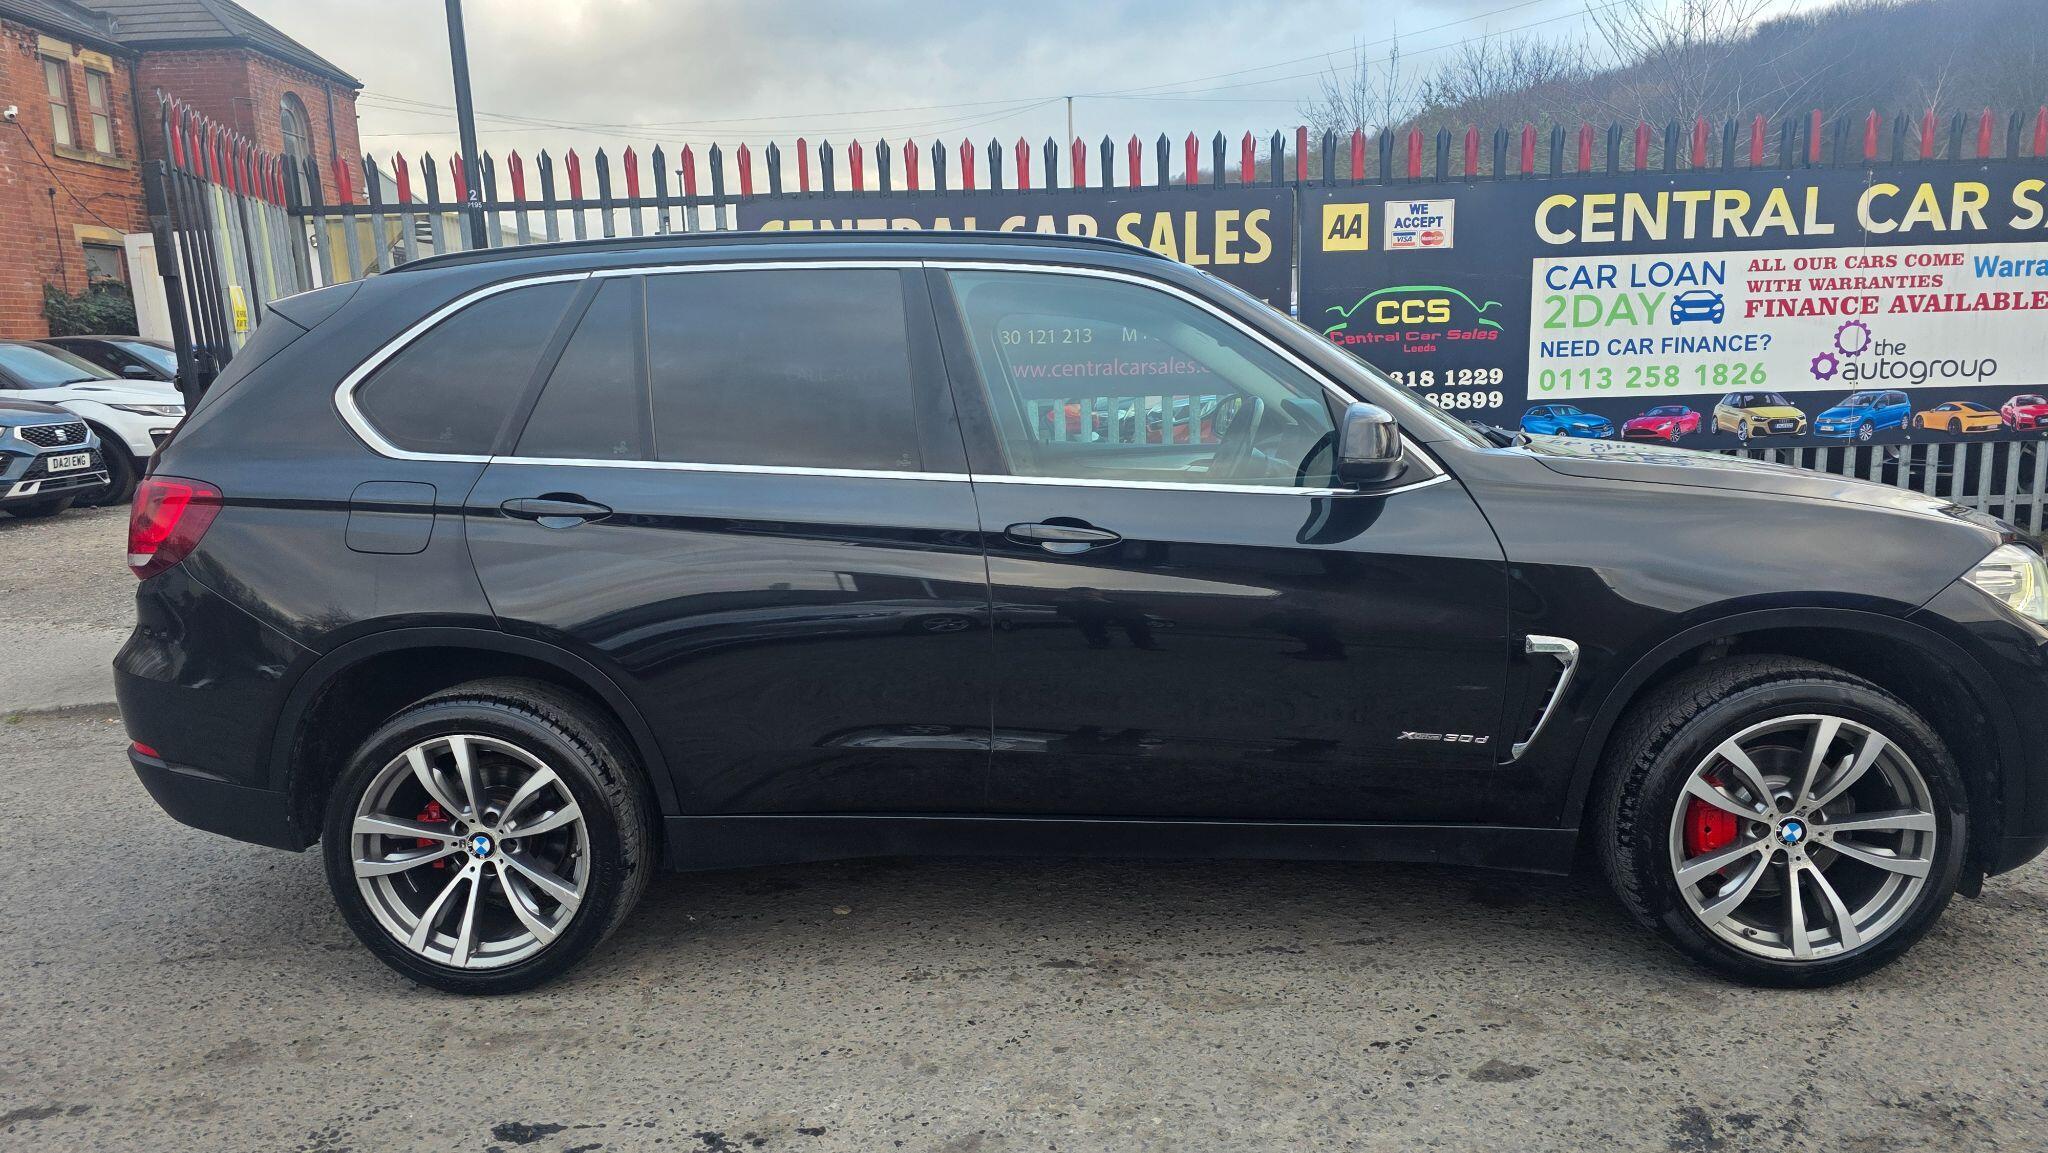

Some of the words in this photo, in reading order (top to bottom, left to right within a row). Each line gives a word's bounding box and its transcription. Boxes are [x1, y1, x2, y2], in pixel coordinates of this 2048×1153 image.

[469, 189, 478, 201] 2
[1409, 203, 1429, 215] WE
[1534, 186, 1835, 245] CENTRAL
[1857, 181, 1990, 234] CAR
[2008, 179, 2048, 230] S
[1327, 214, 1362, 239] AA
[1394, 216, 1443, 229] ACCEPT
[1116, 208, 1272, 265] SALES
[1748, 258, 1786, 272] ALL
[1793, 256, 1838, 271] OUR
[1844, 254, 1898, 269] CARS
[1904, 253, 1965, 268] COME
[1973, 255, 2048, 278] Warra
[1545, 264, 1617, 291] CAR
[1631, 260, 1726, 288] LOAN
[1747, 279, 1802, 293] WITH
[1809, 274, 1944, 291] WARRANTIES
[1376, 299, 1451, 325] CCS
[1543, 291, 1666, 329] 2DAY
[1744, 296, 1880, 319] FINANCE
[1888, 291, 2048, 314] AVAILABLE
[1028, 329, 1055, 344] 121
[1062, 328, 1092, 344] 213
[1330, 330, 1400, 346] Central
[1405, 331, 1442, 342] Car
[1446, 328, 1499, 341] Sales
[1540, 340, 1600, 358] NEED
[1607, 338, 1654, 355] CAR
[1661, 334, 1772, 354] FINANCE?
[1403, 343, 1437, 353] Leeds
[1874, 339, 1907, 356] the
[1444, 368, 1504, 386] 1229
[1539, 367, 1612, 391] 0113
[1625, 365, 1680, 389] 258
[1695, 362, 1768, 387] 1826
[1842, 358, 1998, 385] autogroup
[53, 457, 71, 469] DA21
